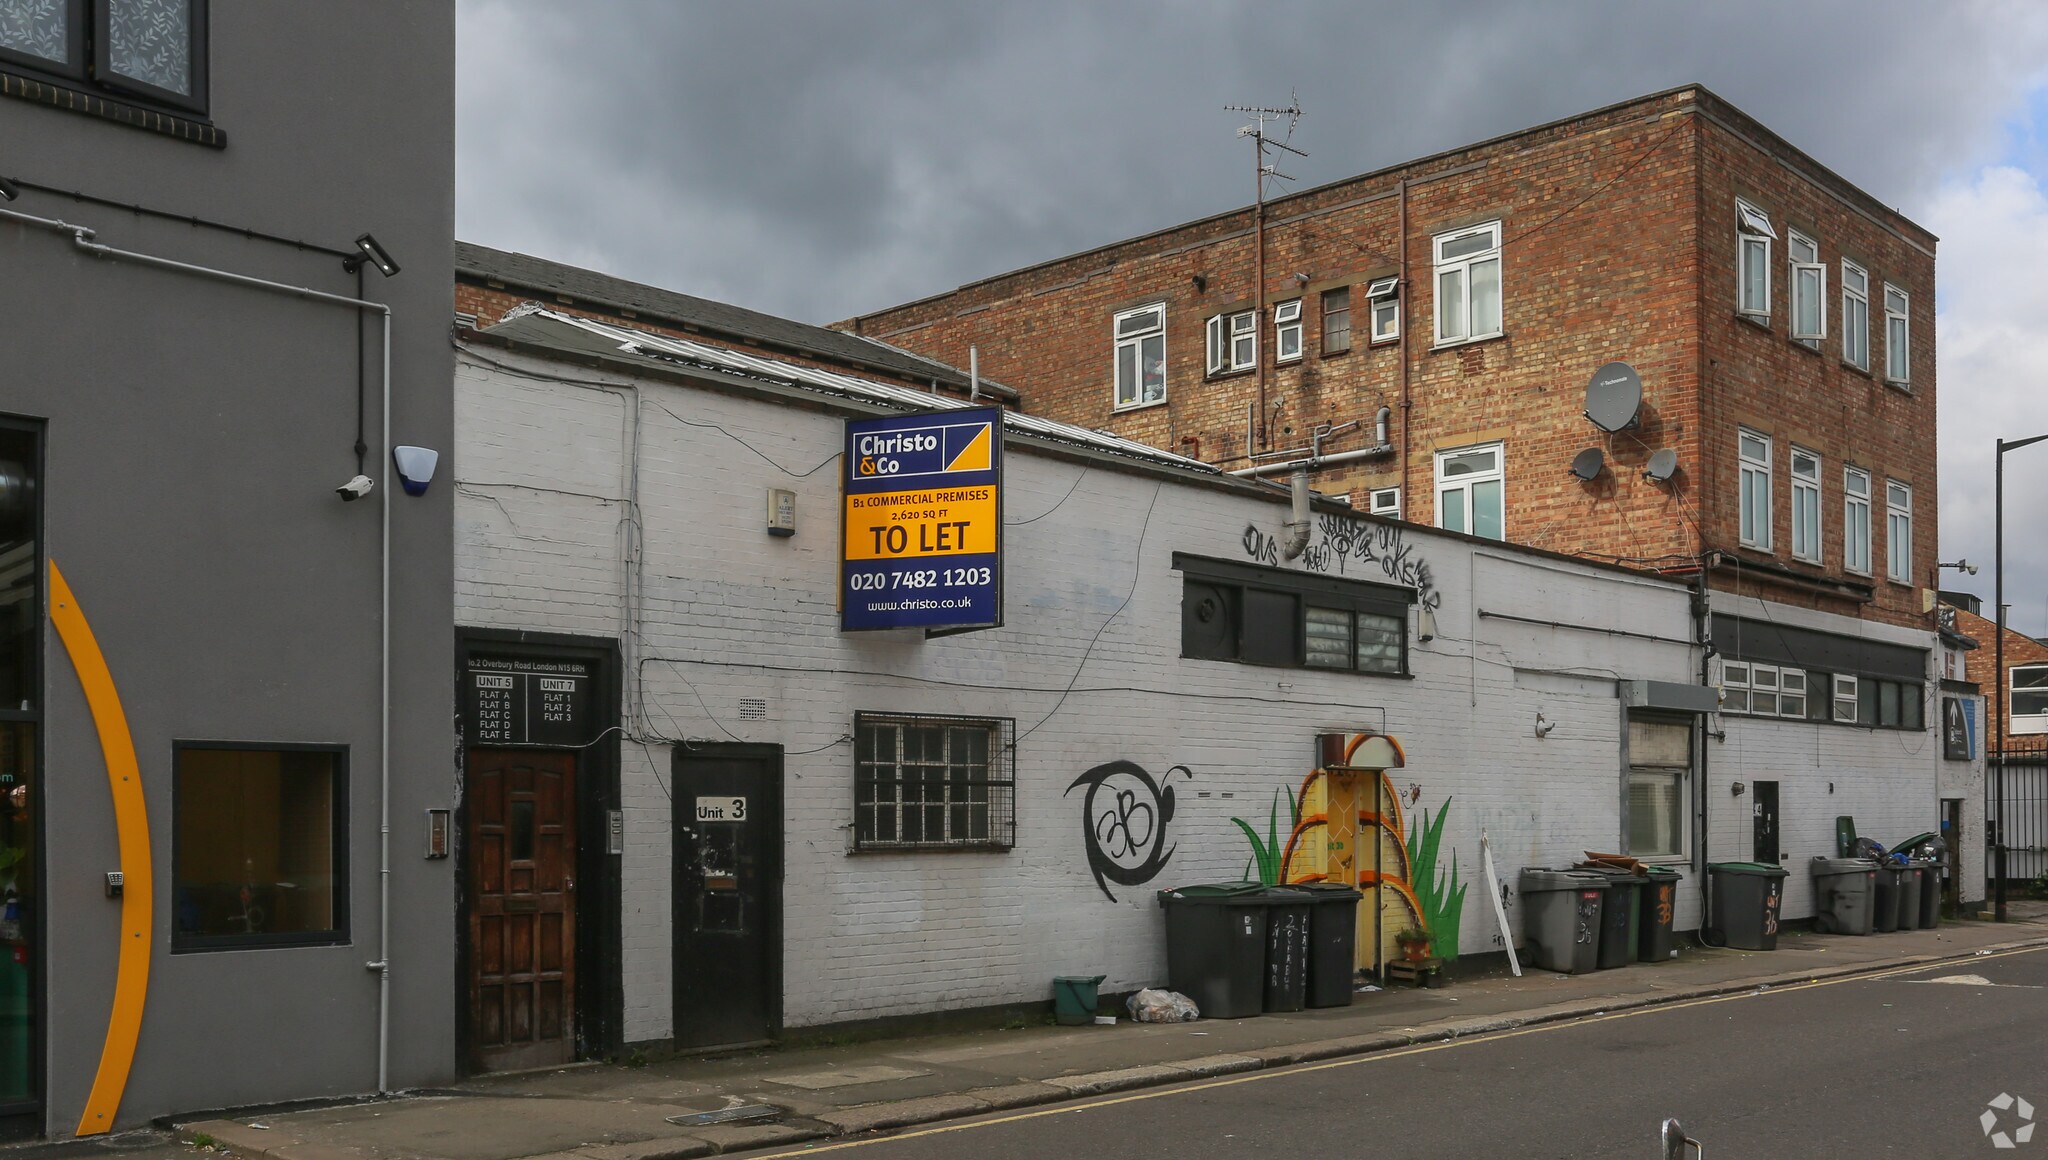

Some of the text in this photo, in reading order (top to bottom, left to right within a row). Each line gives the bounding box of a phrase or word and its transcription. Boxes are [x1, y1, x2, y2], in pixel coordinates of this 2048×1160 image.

[860, 433, 938, 456] Christo
[853, 490, 989, 508] B1 COMMERCIAL PREMISES
[891, 509, 948, 522] 2,620 SQ FT
[870, 521, 971, 555] TO LET
[850, 567, 991, 591] 020 7482 1203
[868, 596, 972, 612] www.christo.co.uk
[482, 660, 512, 670] Overbury
[514, 661, 532, 670] Road
[532, 662, 557, 672] London
[558, 664, 570, 672] N15
[572, 664, 585, 673] 6RH
[478, 676, 512, 687] UNIT 5
[542, 680, 574, 690] UNIT 7
[480, 691, 500, 699] FLAT
[567, 694, 571, 702] 1
[480, 701, 500, 709] FLAT
[544, 703, 572, 712] FLAT 2
[480, 710, 510, 719] FLAT C
[544, 713, 564, 721] FLAT
[480, 720, 510, 729] FLAT D
[480, 730, 510, 739] FLAT E
[698, 799, 744, 819] Unit 3
